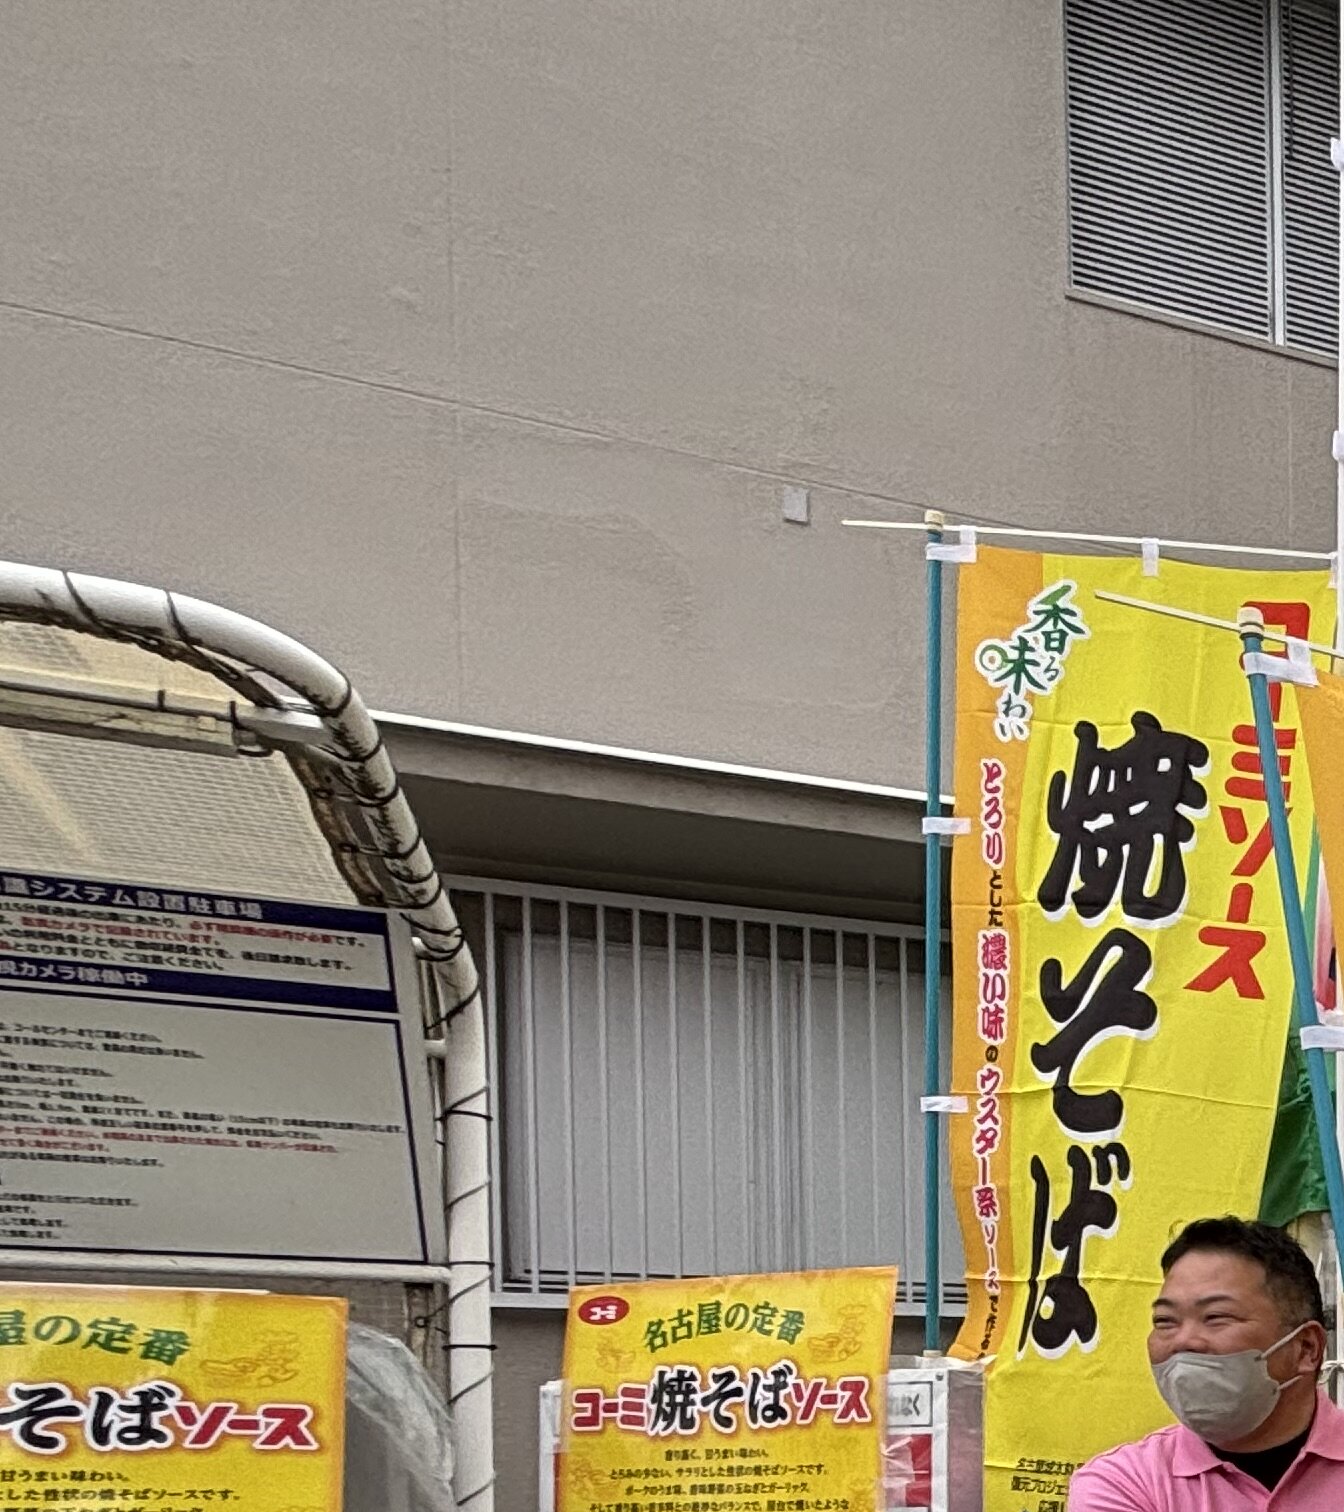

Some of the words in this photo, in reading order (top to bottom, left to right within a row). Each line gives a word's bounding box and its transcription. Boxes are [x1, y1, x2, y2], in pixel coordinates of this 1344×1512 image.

[1018, 711, 1211, 1354] 焼そば
[644, 1300, 806, 1353] 名古屋の定番
[572, 1363, 871, 1436] コーミ焼そばソース
[0, 1487, 241, 1501] した性状の焼そばソースです。
